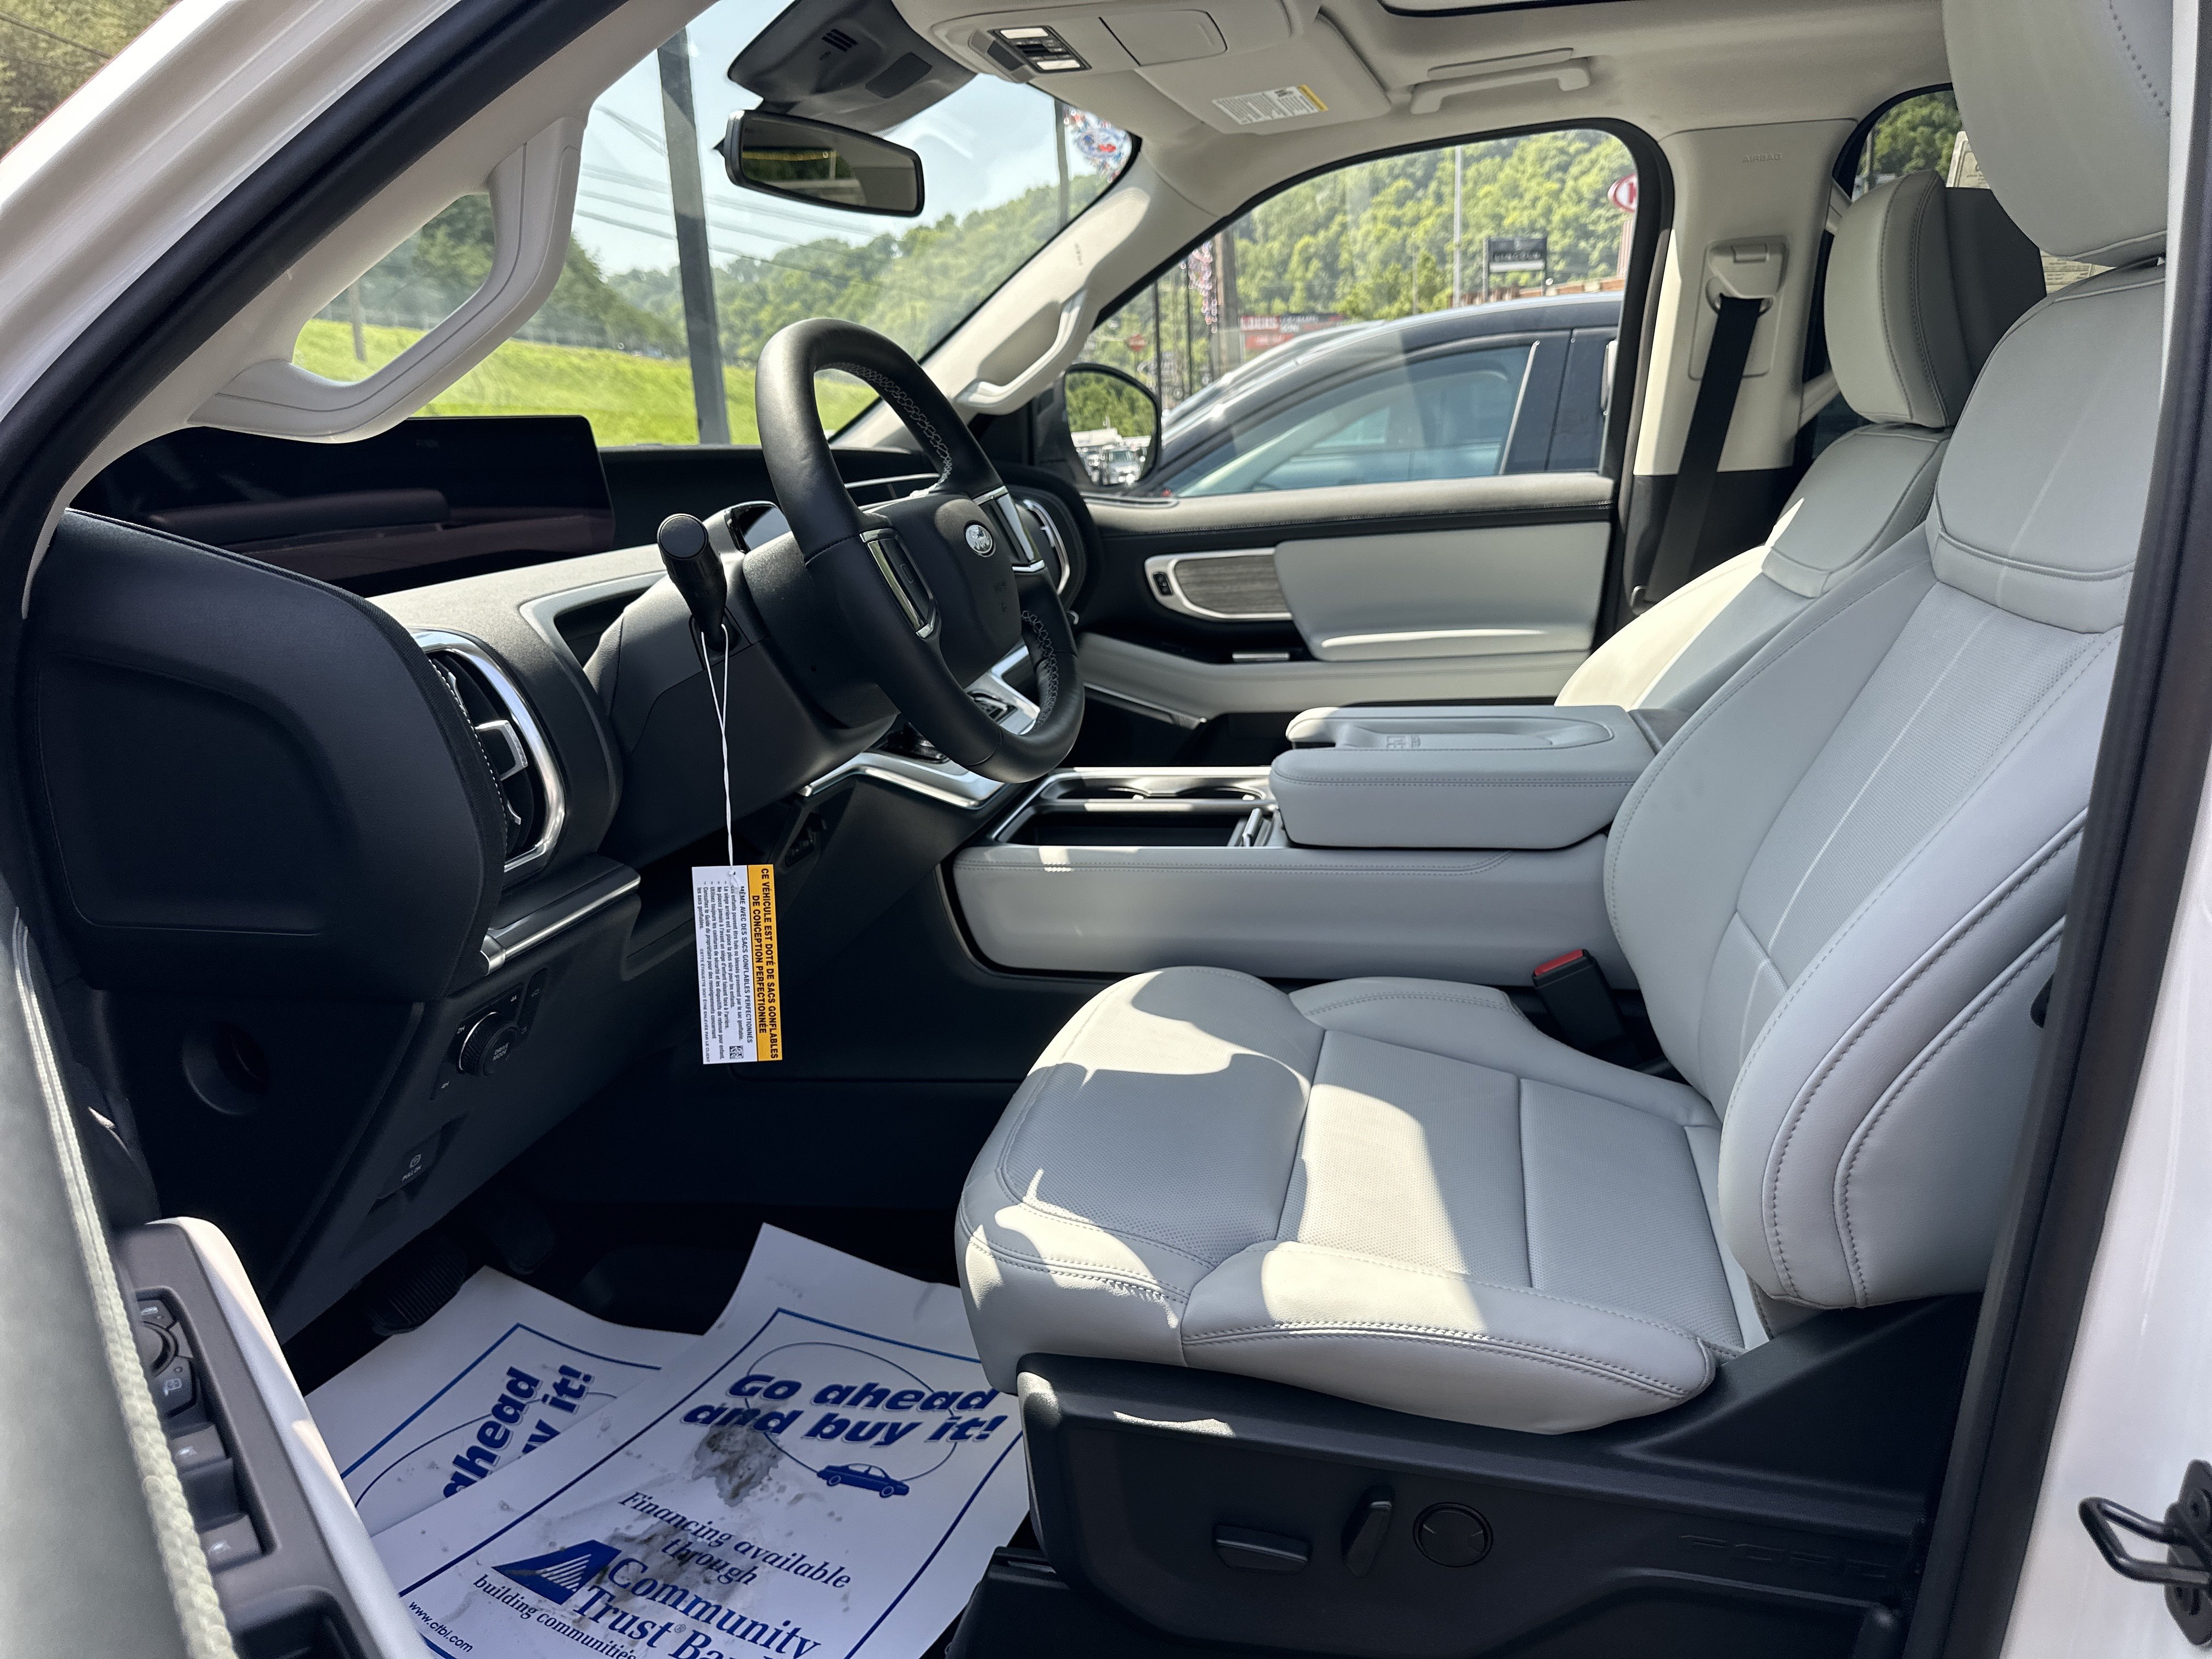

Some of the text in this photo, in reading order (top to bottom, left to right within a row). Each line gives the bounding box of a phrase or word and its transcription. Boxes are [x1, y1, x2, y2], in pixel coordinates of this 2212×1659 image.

[1742, 153, 1782, 163] AIRBAG
[761, 868, 769, 879] CE
[763, 882, 773, 922] VÉHICULE
[752, 895, 769, 1033] DE CONCEPTION PERFECTIONNÉE
[765, 944, 775, 966] DOTÉ
[766, 968, 774, 979] DE
[745, 995, 754, 1042] PERFECTIONNÉS
[769, 1006, 778, 1058] GONFLABLES
[541, 1364, 594, 1414] it!
[727, 1374, 1000, 1412] Go ahead
[681, 1404, 1008, 1448] and buy it!
[619, 1491, 851, 1588] Financing available
[661, 1538, 758, 1585] through
[473, 1574, 539, 1619] building
[608, 1558, 821, 1659] Community
[408, 1601, 473, 1653] www.ctbi.com
